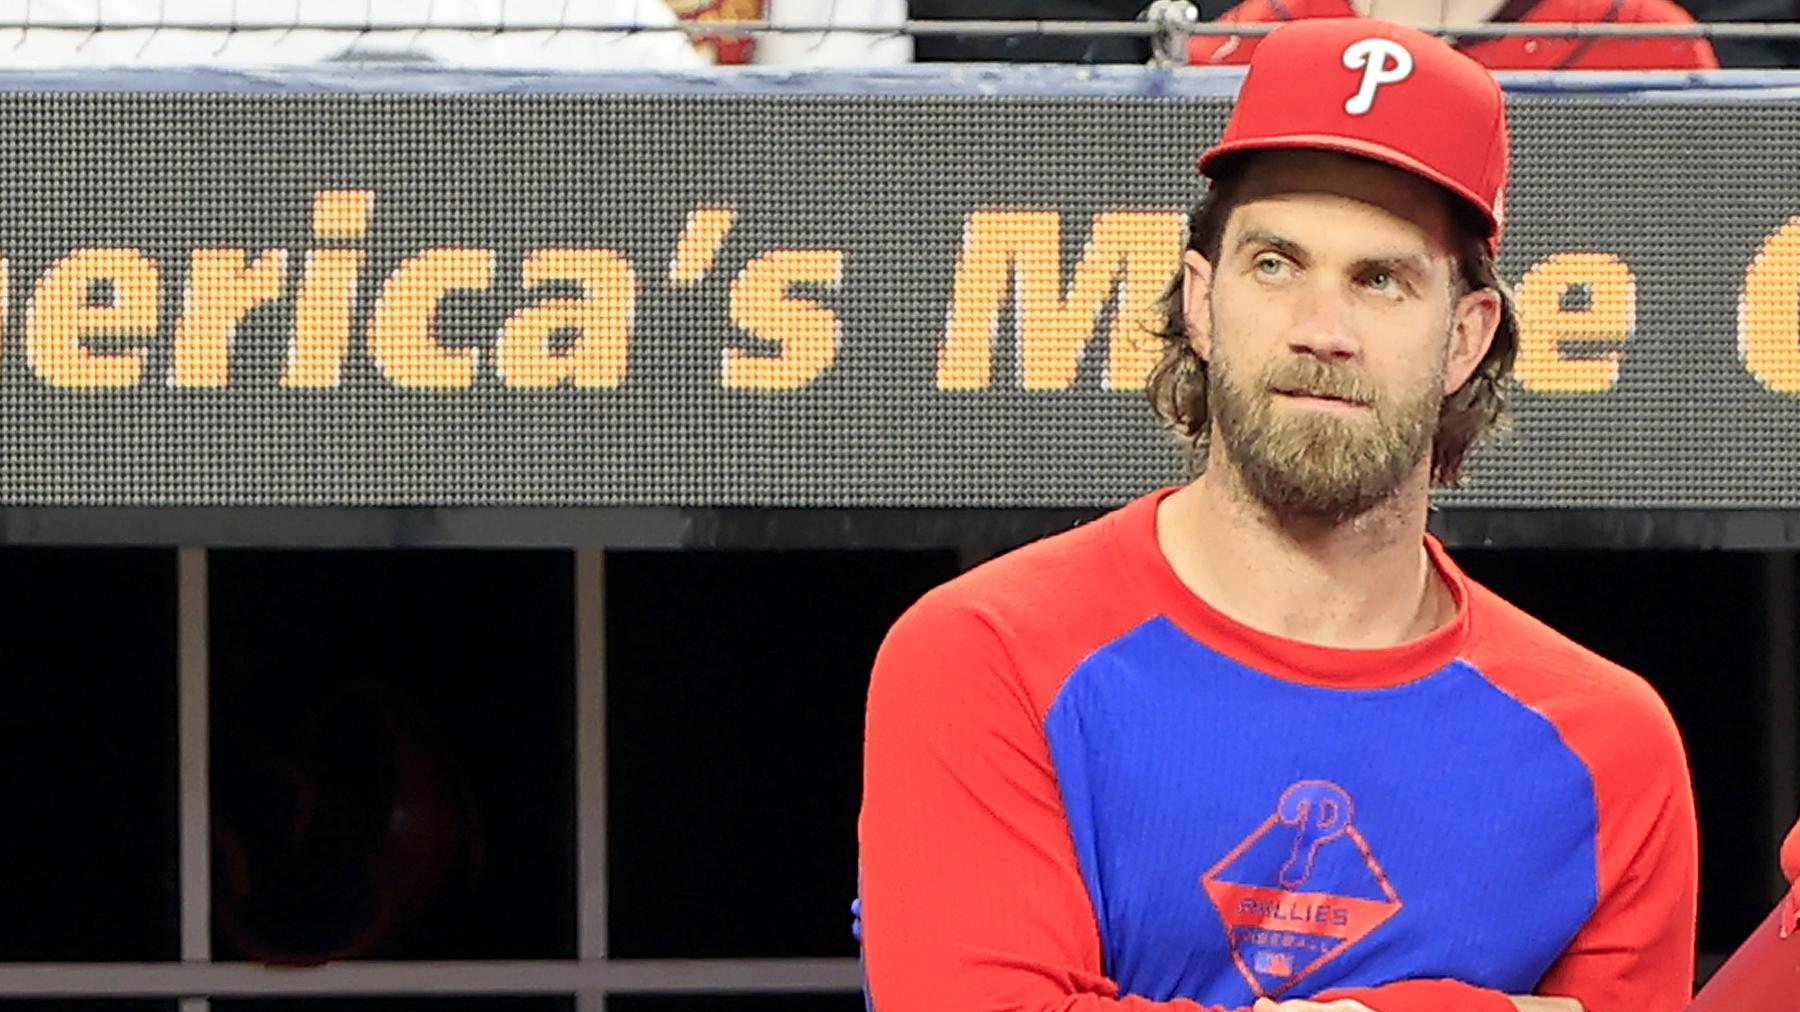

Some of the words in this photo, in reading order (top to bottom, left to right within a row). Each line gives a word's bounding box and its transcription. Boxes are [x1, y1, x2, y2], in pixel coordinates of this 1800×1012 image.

[1341, 37, 1415, 116] P
[0, 188, 844, 389] erica's
[936, 207, 1637, 394] Me
